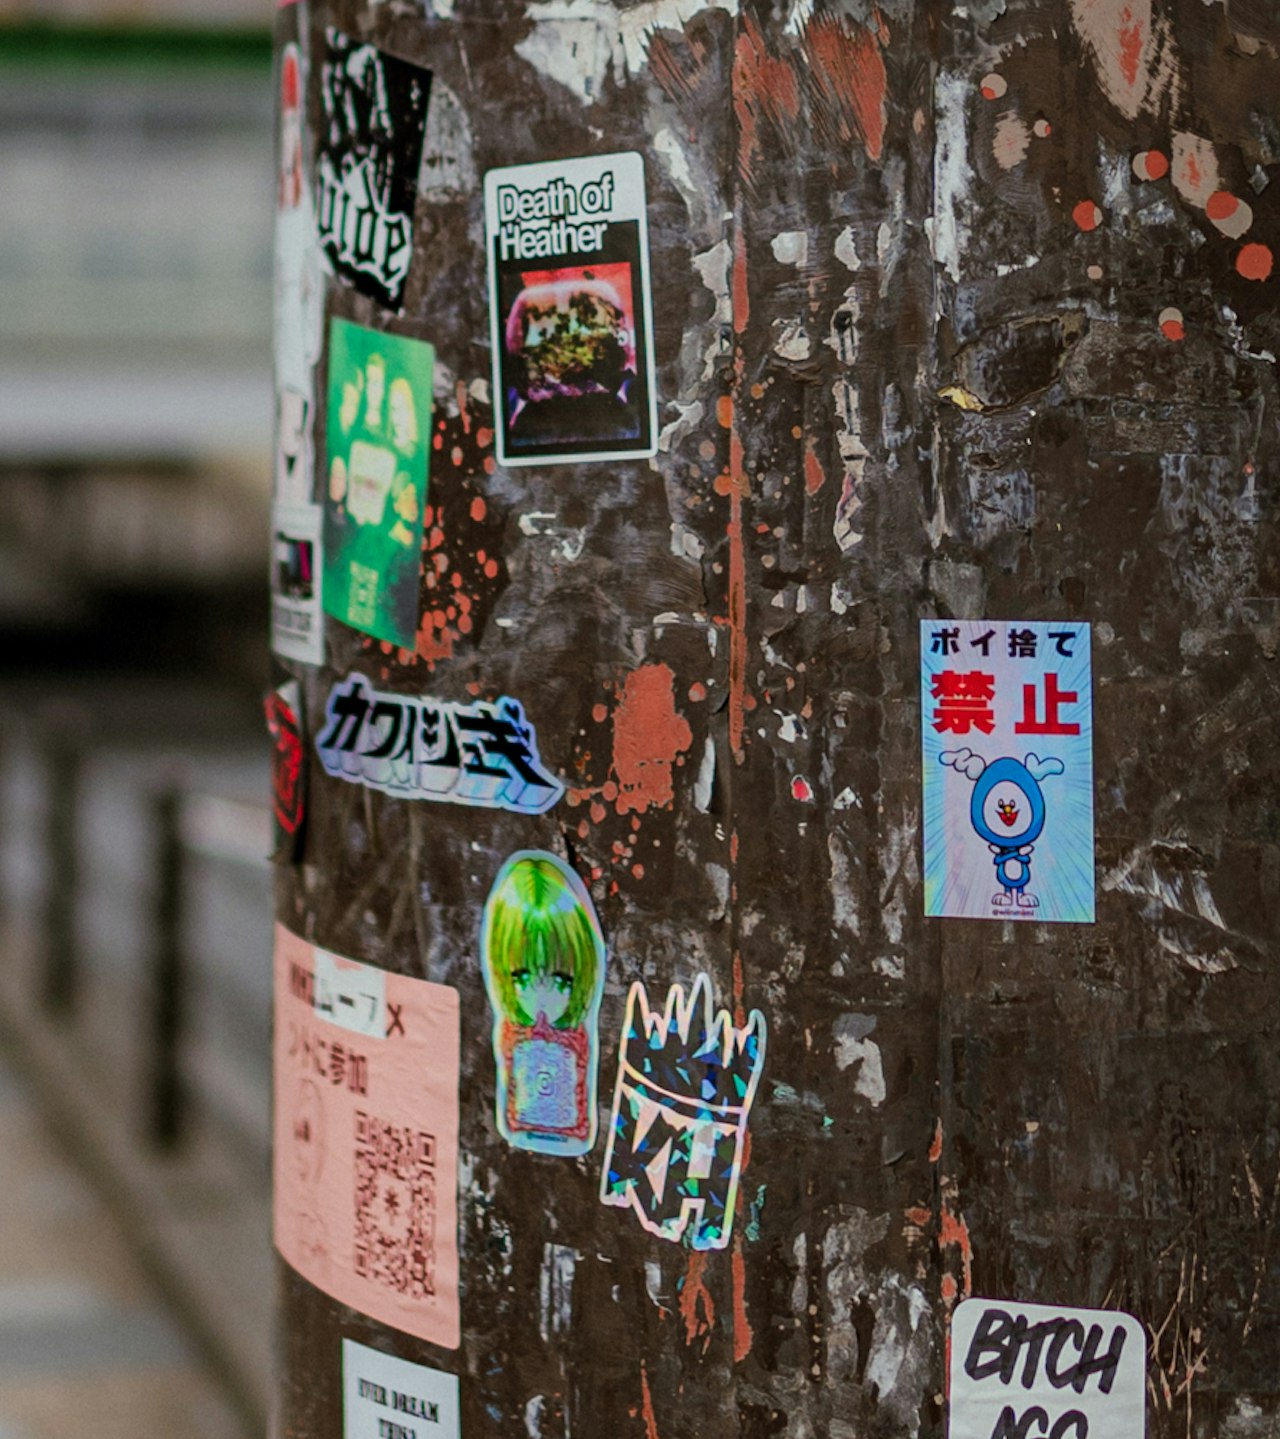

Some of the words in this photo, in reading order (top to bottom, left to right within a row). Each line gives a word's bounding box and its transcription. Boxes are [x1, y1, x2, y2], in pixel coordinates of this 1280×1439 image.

[496, 176, 578, 222] Death
[579, 170, 615, 214] of
[499, 218, 609, 262] Heather
[929, 627, 1077, 659] ポイ捨て
[930, 669, 1081, 737] 禁止
[964, 1307, 1128, 1395] BITCH
[357, 1377, 388, 1408] EVER
[391, 1388, 440, 1424] DREAM
